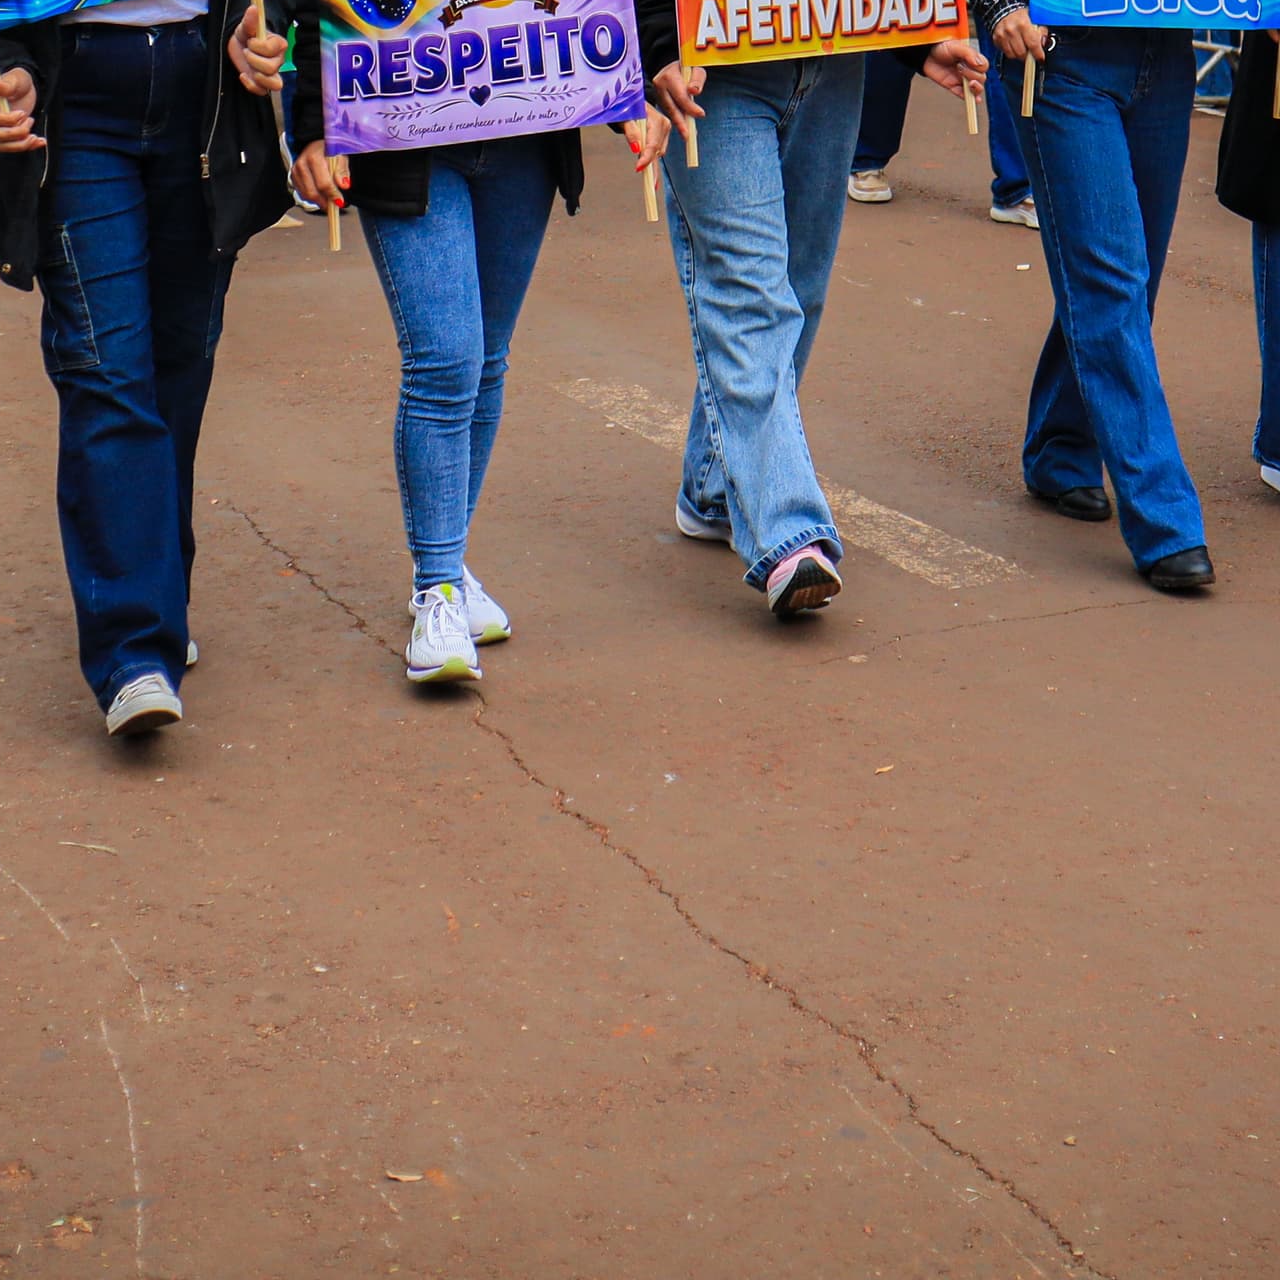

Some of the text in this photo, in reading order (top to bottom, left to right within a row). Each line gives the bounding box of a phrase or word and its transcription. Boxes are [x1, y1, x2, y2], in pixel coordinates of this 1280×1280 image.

[335, 11, 628, 100] RESPEITO
[408, 123, 446, 138] Respeitar
[456, 117, 496, 129] reconhecer
[504, 111, 524, 124] valor
[527, 111, 536, 121] do
